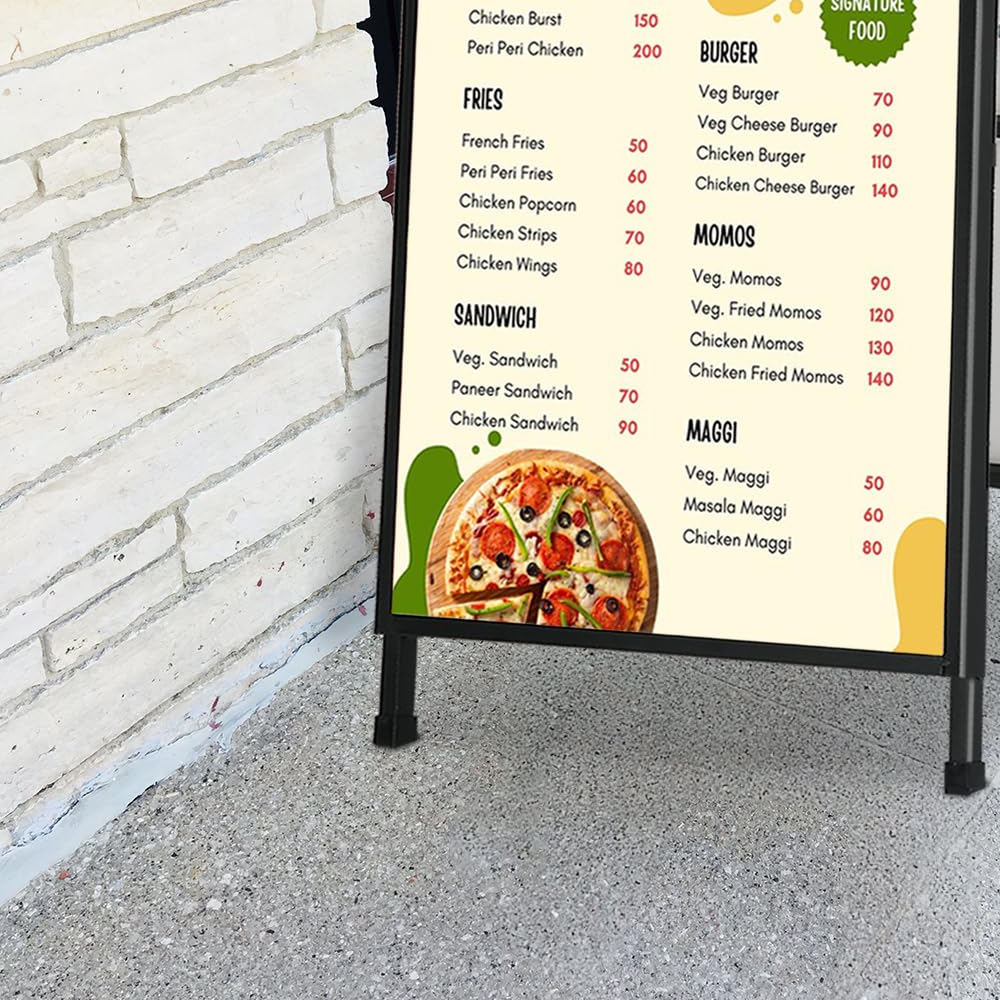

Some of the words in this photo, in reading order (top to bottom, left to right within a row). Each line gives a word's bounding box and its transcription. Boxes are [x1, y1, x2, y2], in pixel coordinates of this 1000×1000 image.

[469, 9, 524, 25] Chicken
[529, 11, 562, 26] Burst
[635, 14, 658, 28] 150
[849, 21, 885, 40] FOOD
[468, 40, 493, 54] Peri
[498, 41, 523, 55] Peri
[528, 41, 583, 56] Chicken
[633, 44, 662, 59] 200
[700, 40, 758, 64] BURGER
[464, 87, 503, 110] FRIES
[699, 85, 727, 104] Veg
[732, 85, 779, 105] Burger
[873, 92, 893, 107] 70
[698, 115, 726, 134] Veg
[731, 115, 785, 131] Cheese
[791, 117, 837, 137] Burger
[873, 123, 893, 137] 90
[462, 133, 508, 148] French
[513, 135, 545, 150] Fries
[628, 138, 648, 152] 50
[696, 145, 754, 161] Chicken
[759, 147, 806, 167] Burger
[872, 154, 892, 168] 110
[461, 164, 486, 178] Peri
[491, 164, 516, 179] Peri
[521, 165, 553, 181] Fries
[628, 169, 647, 184] 60
[695, 176, 750, 191] Chicken
[754, 178, 806, 193] Cheese
[811, 180, 855, 199] Burger
[872, 184, 898, 198] 140
[459, 193, 515, 209] Chicken
[520, 195, 576, 214] Popcorn
[626, 200, 646, 214] 60
[458, 224, 514, 240] Chicken
[518, 226, 557, 245] Strips
[625, 231, 645, 245] 70
[694, 223, 755, 248] MOMOS
[457, 254, 512, 270] Chicken
[516, 257, 557, 277] Wings
[624, 261, 643, 276] 80
[693, 269, 725, 288] Veg.
[730, 271, 782, 287] Momos
[871, 276, 891, 291] 90
[454, 303, 536, 328] SANDWICH
[691, 300, 724, 320] Veg.
[729, 301, 766, 317] Fried
[769, 304, 822, 320] Momos
[869, 308, 894, 323] 120
[690, 331, 748, 348] Chicken
[752, 335, 804, 351] Momos
[868, 340, 893, 355] 130
[453, 350, 485, 369] Veg.
[490, 351, 558, 368] Sandwich
[620, 358, 640, 372] 50
[689, 362, 747, 379] Chicken
[751, 365, 788, 381] Fried
[791, 368, 844, 384] Momos
[867, 372, 893, 386] 140
[452, 380, 500, 396] Paneer
[504, 383, 573, 400] Sandwich
[619, 389, 639, 404] 70
[450, 410, 506, 427] Chicken
[511, 414, 579, 431] Sandwich
[618, 420, 638, 435] 90
[686, 419, 737, 444] MAGGI
[685, 465, 718, 486] Veg.
[723, 468, 770, 488] Maggi
[864, 475, 884, 491] 50
[684, 497, 736, 514] Masala
[740, 500, 787, 521] Maggi
[863, 508, 884, 523] 60
[683, 529, 741, 546] Chicken
[745, 534, 792, 554] Maggi
[862, 540, 882, 555] 80
